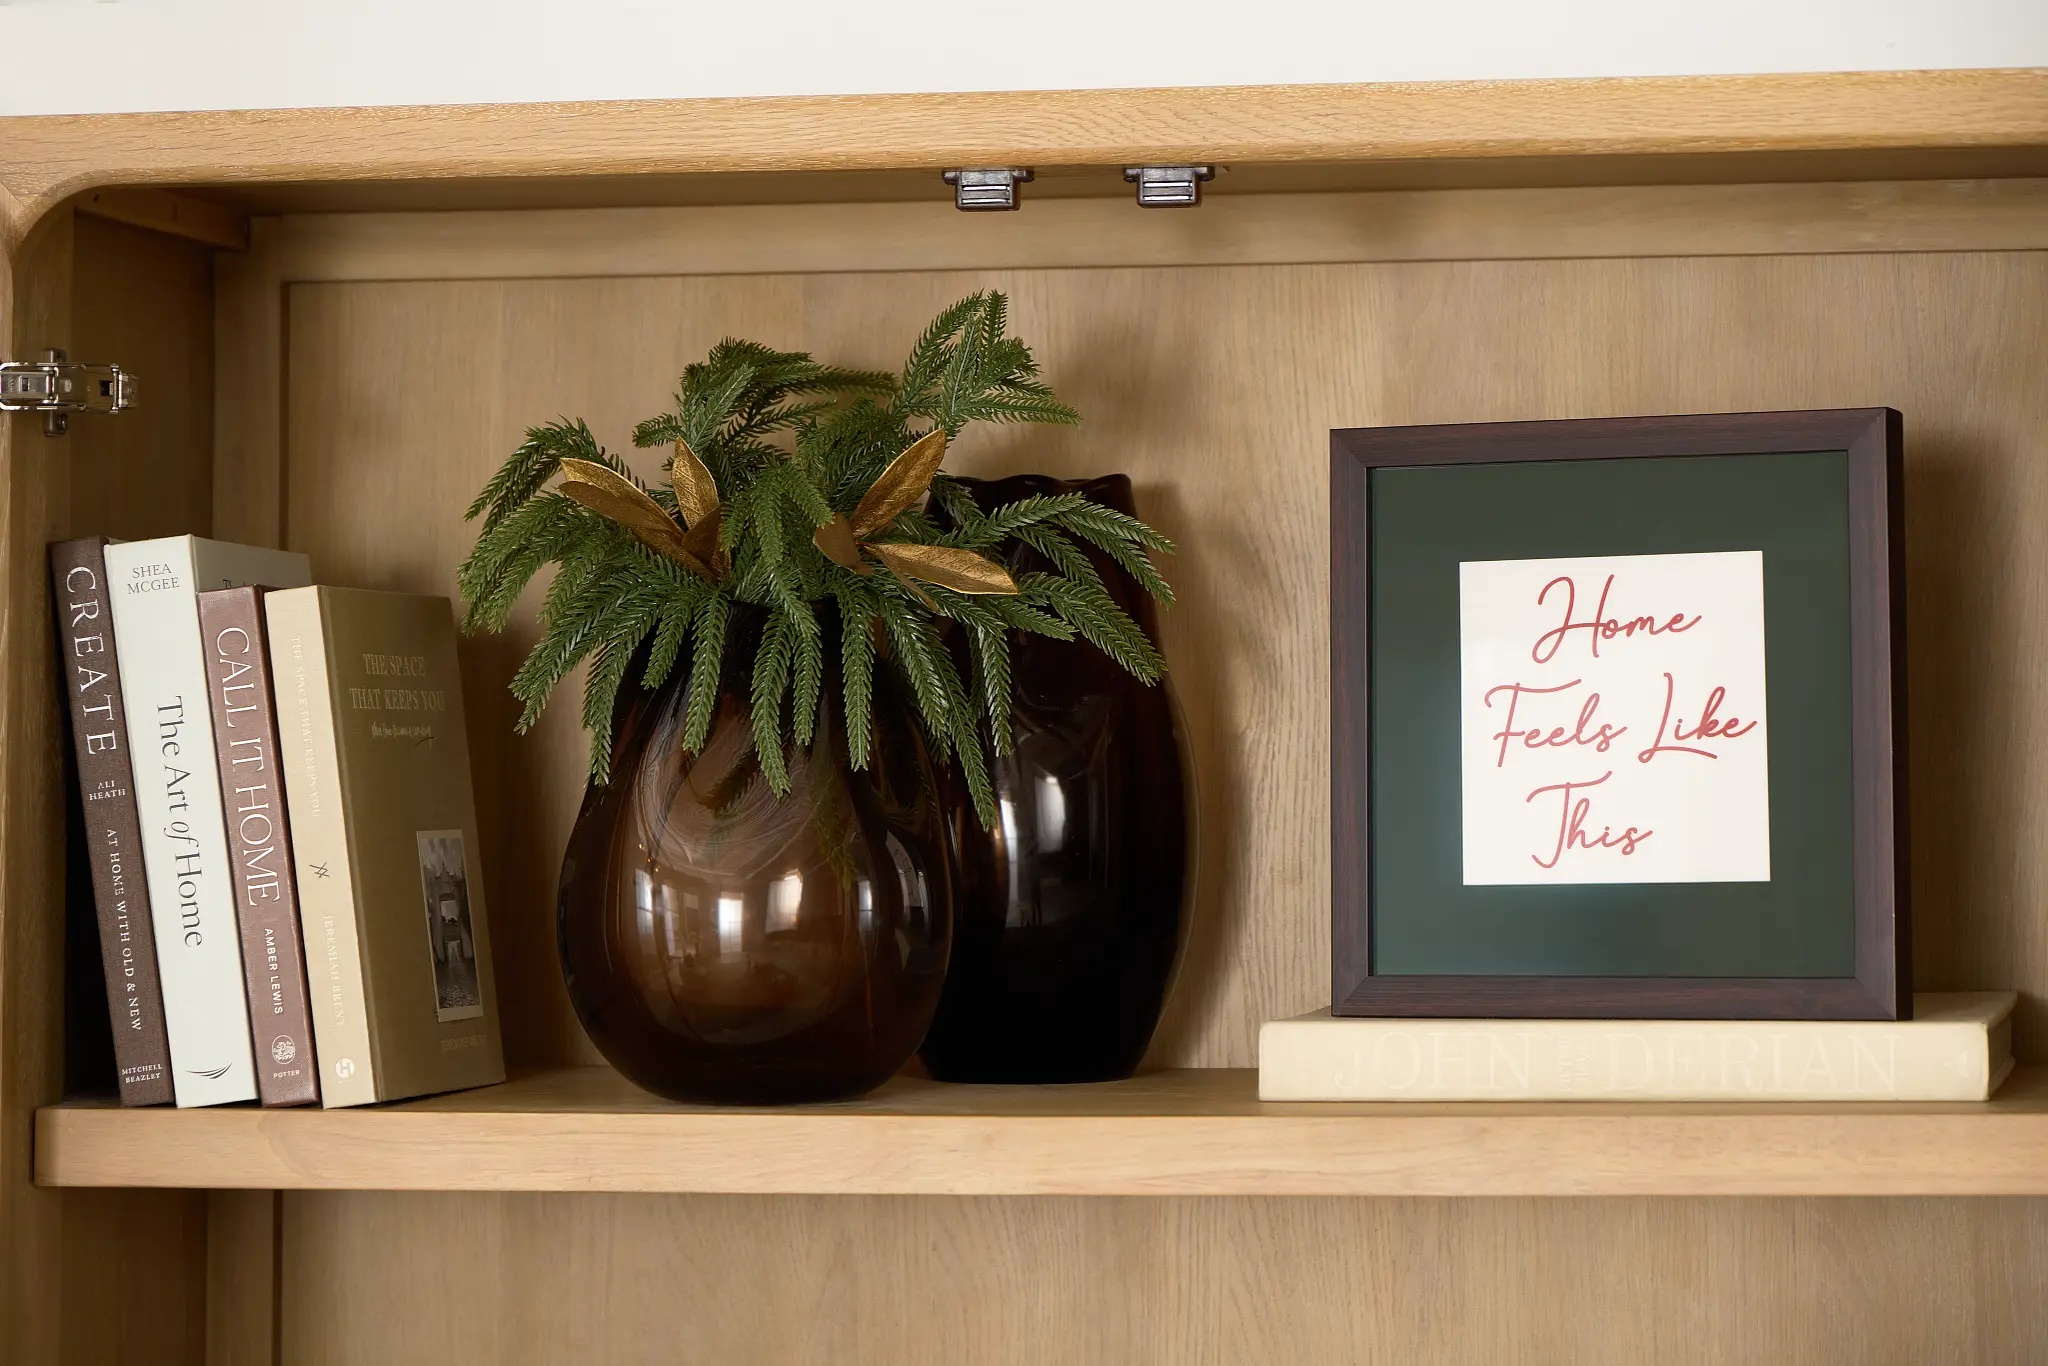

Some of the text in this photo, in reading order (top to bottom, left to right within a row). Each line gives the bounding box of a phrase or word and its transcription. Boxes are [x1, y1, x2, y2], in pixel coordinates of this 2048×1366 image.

[127, 576, 180, 595] MCGEE
[132, 563, 172, 579] SHEA
[1531, 574, 1702, 664] Home
[66, 566, 117, 755] CREATE
[216, 627, 257, 728] CALL
[362, 653, 426, 676] THE SPACE
[290, 633, 322, 818] THE SPACE THAT KEEPS YOU
[349, 687, 446, 711] THAT KEEPS YOU
[1484, 672, 1758, 768] Feels Like
[98, 780, 115, 790] ALI
[229, 737, 265, 772] IT
[89, 788, 126, 801] HEATH
[157, 695, 203, 948] The Art of Home
[1526, 770, 1653, 869] This
[235, 783, 281, 907] HOME
[106, 829, 141, 1031] AT HOME WITH OLD & NEW
[264, 927, 283, 1015] AMBER LEWIS
[121, 1063, 163, 1076] MITCHELL
[125, 1072, 161, 1084] BEAZLEY
[273, 1070, 300, 1079] POTTER
[1332, 1030, 1537, 1091] JOHN
[1602, 1031, 1900, 1093] DERIAN
